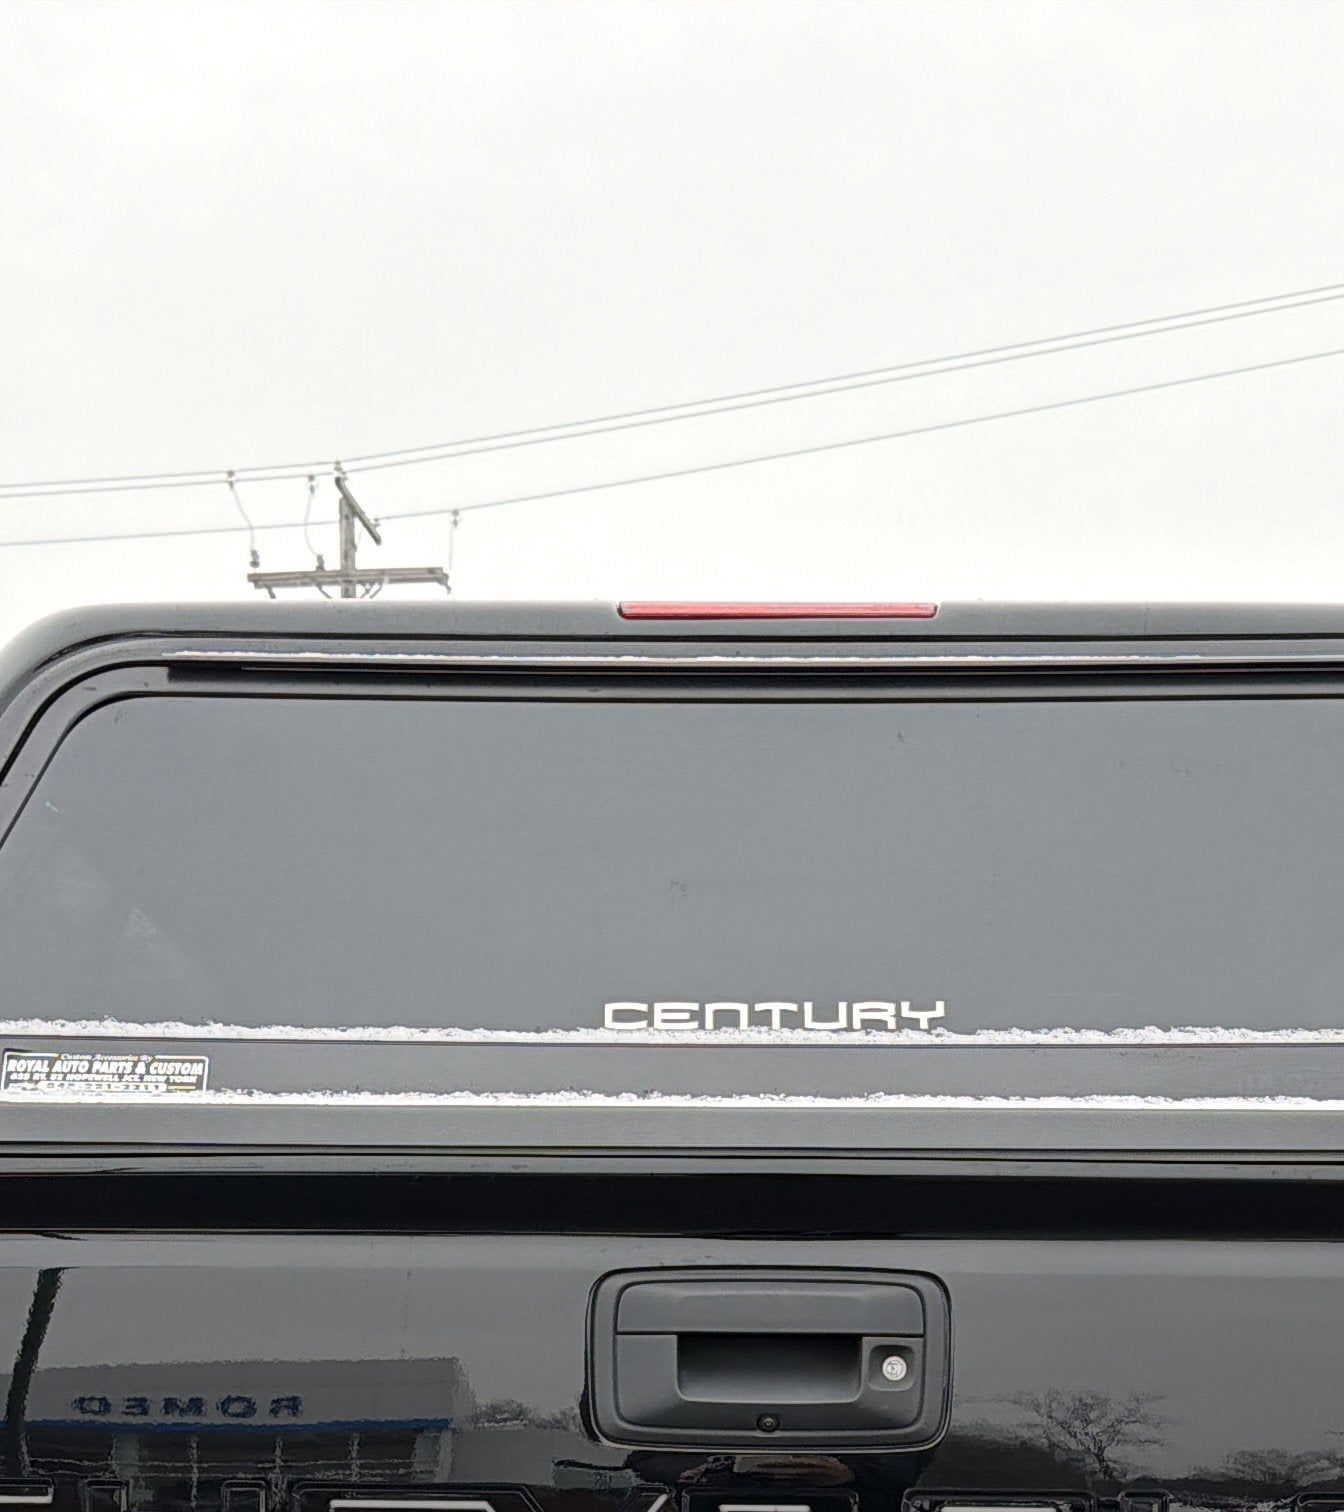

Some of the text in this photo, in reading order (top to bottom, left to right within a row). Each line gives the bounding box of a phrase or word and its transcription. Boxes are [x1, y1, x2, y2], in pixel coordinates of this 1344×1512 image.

[604, 1000, 946, 1030] CENTURY
[7, 1059, 204, 1075] ROYAL AUTO PARTS & CUSTOM
